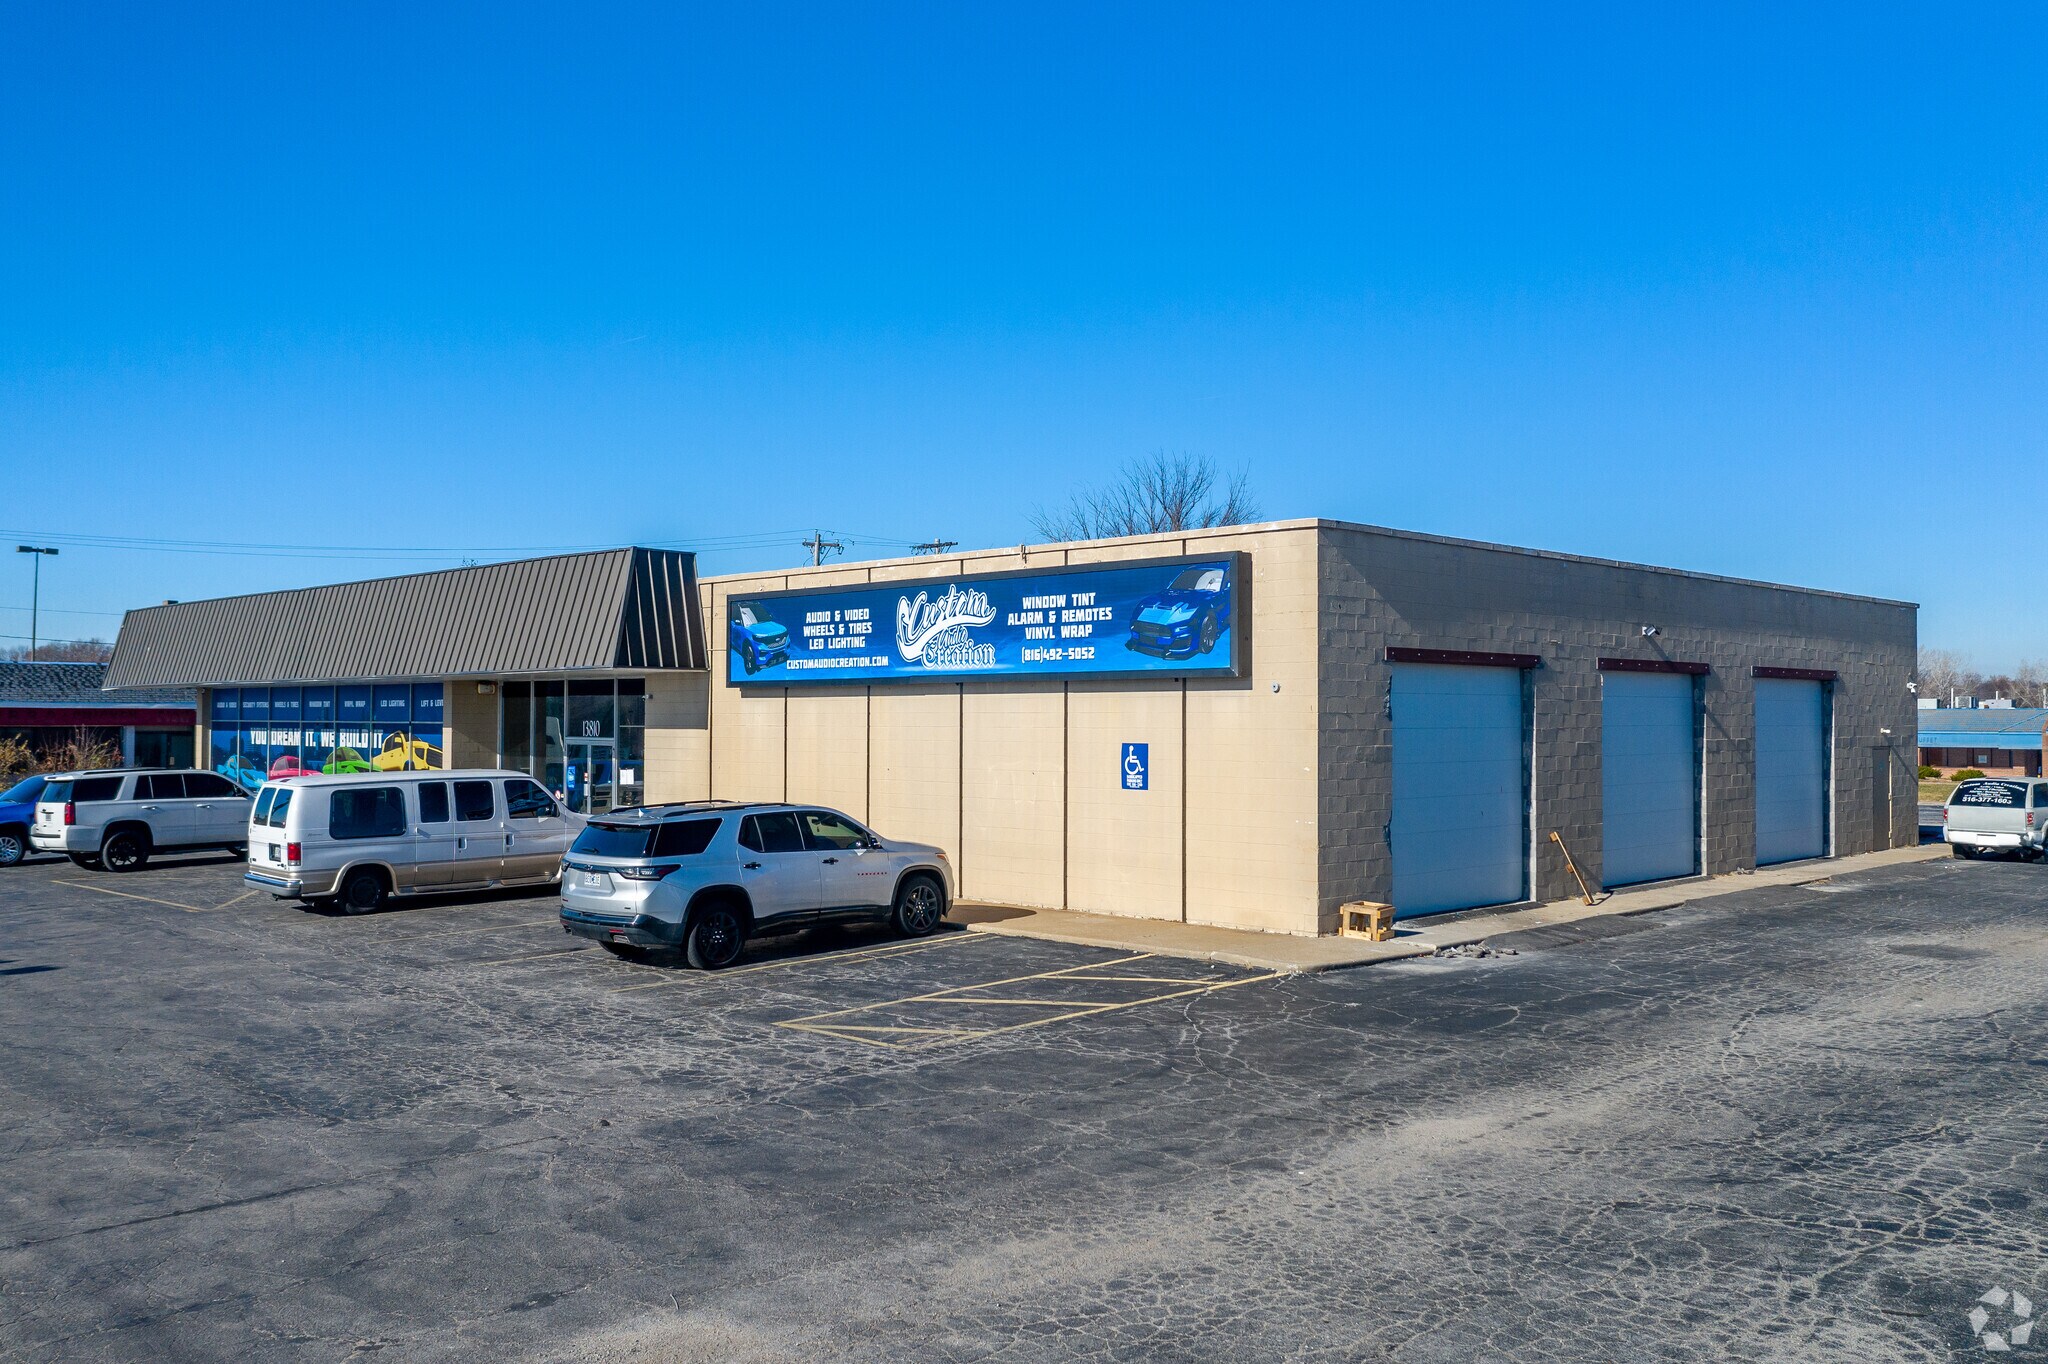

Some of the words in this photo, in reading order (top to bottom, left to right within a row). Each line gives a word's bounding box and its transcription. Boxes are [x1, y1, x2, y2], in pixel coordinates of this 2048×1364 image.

[1022, 594, 1067, 610] WINDOW
[1071, 592, 1096, 607] TINT
[805, 611, 831, 624] AUDIO
[834, 610, 841, 622] &
[844, 608, 869, 621] VIDEO
[896, 584, 997, 652] Custom
[1007, 611, 1044, 626] ALARM
[1048, 610, 1057, 624] &
[1061, 607, 1113, 623] REMOTES
[803, 624, 835, 637] WHEELS
[838, 623, 845, 635] &
[848, 622, 872, 634] TIRES
[1025, 626, 1056, 640] VINYL
[1060, 624, 1093, 638] WRAP
[809, 638, 824, 650] LED
[828, 636, 866, 649] LIGHTING
[921, 638, 996, 669] Creation
[1021, 646, 1095, 664] (816)492-5052
[786, 656, 889, 670] CUSTOMAUDIOCREATION.COM
[582, 720, 601, 737] 13810
[250, 728, 267, 745] YOU
[270, 728, 301, 746] DREAM
[320, 729, 335, 748] WE
[339, 729, 369, 749] BUILD
